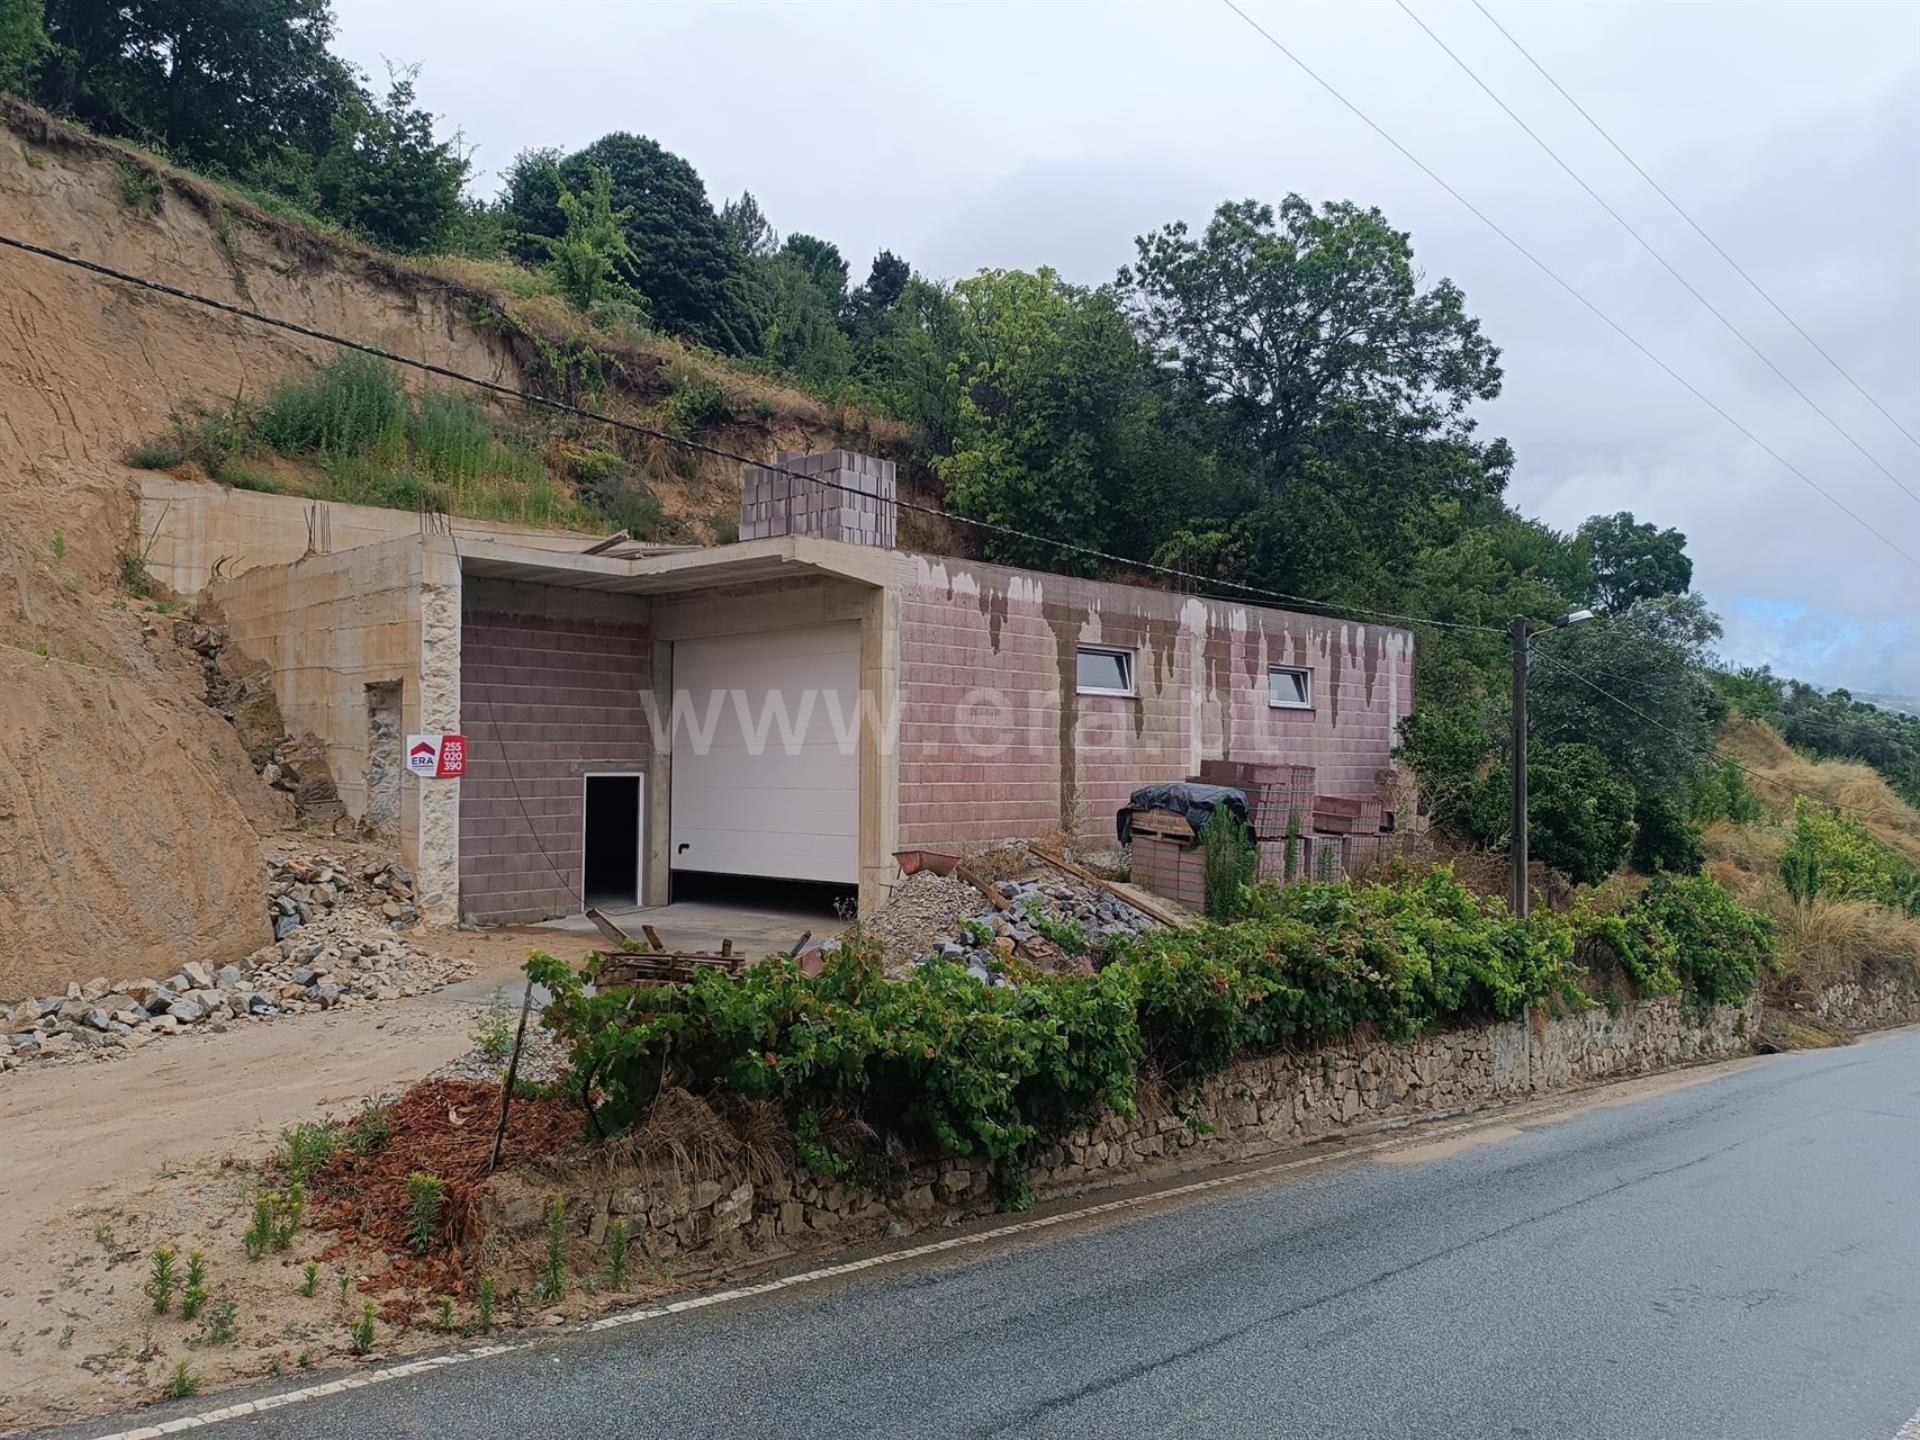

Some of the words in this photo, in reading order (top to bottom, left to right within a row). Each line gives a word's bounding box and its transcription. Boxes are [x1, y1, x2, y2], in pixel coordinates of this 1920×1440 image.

[444, 742, 462, 751] 255
[411, 756, 434, 765] ERA
[443, 752, 463, 761] 020
[443, 761, 462, 771] 390
